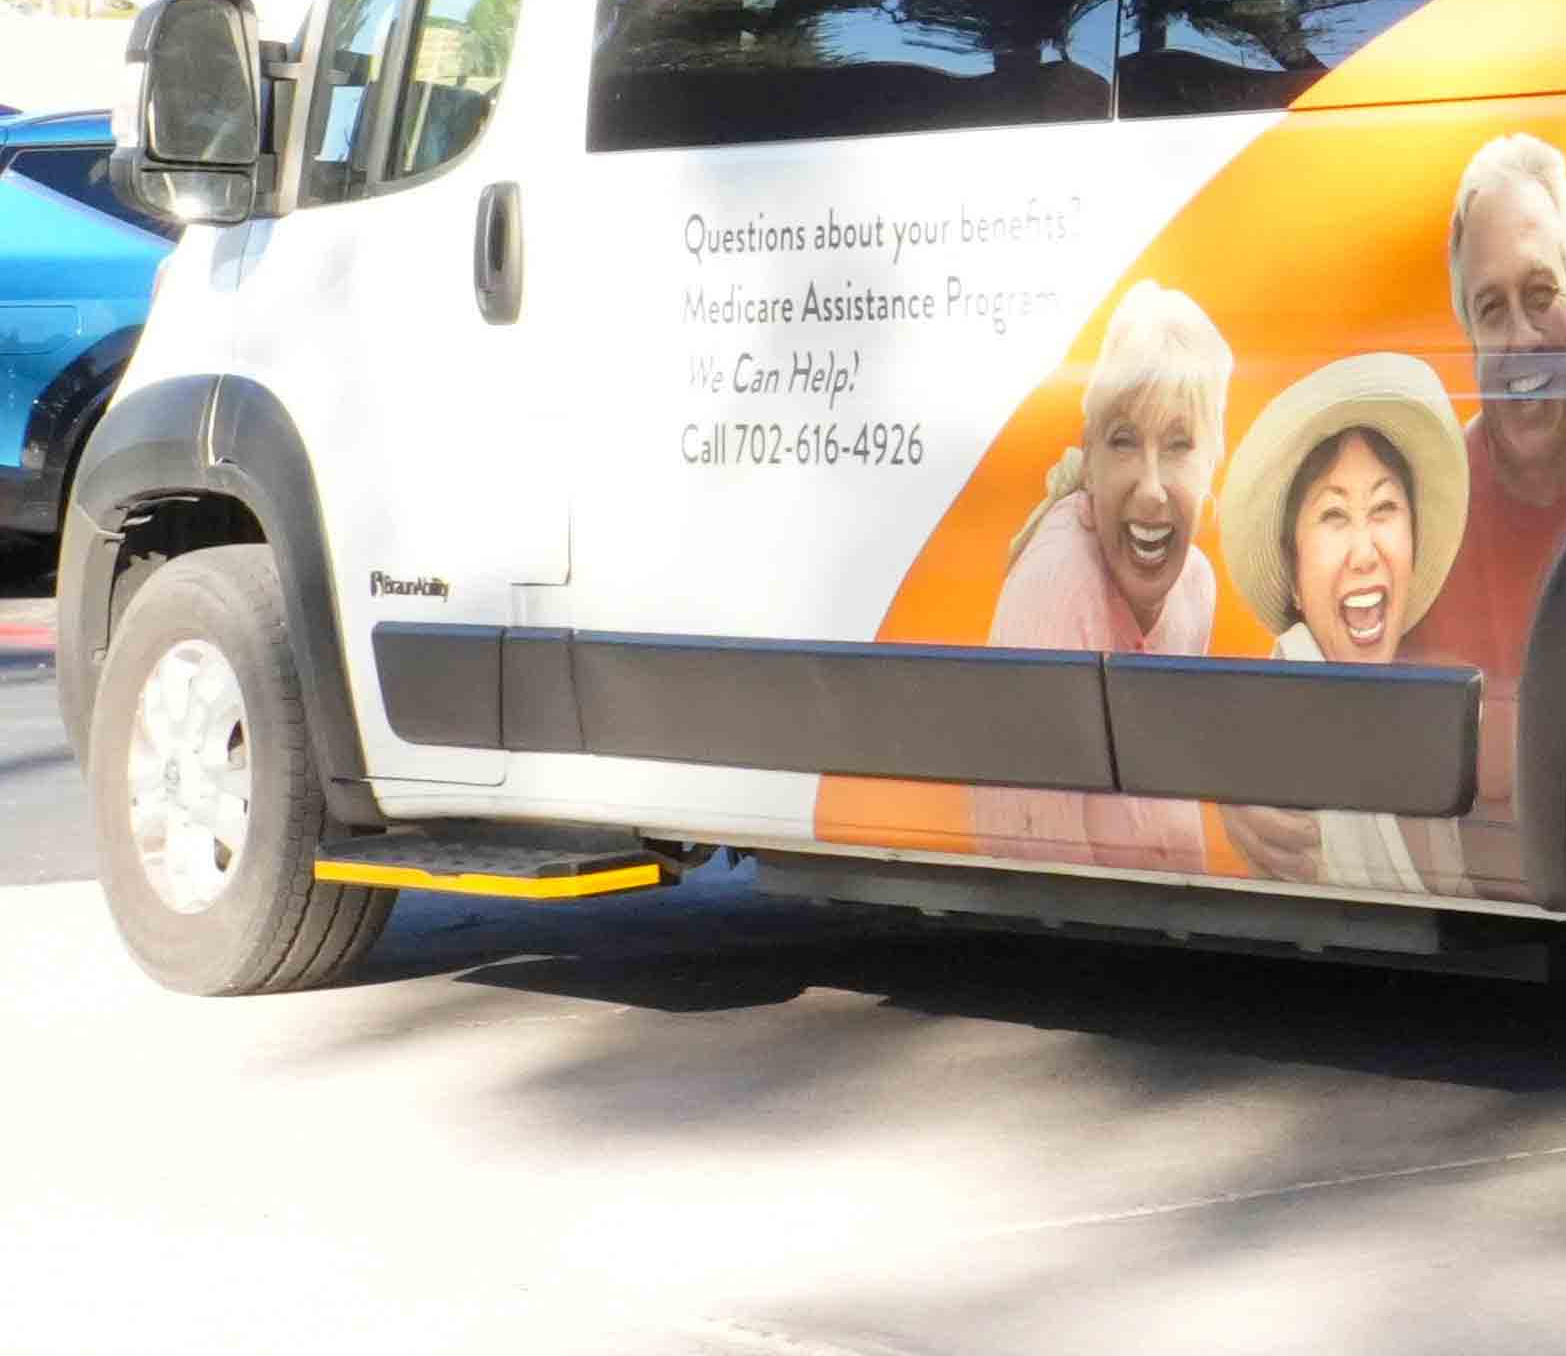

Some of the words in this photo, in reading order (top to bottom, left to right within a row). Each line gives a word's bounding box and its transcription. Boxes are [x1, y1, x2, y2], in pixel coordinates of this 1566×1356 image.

[684, 212, 806, 263] Questions
[814, 207, 885, 250] about
[893, 216, 952, 265] your
[960, 196, 1083, 244] benefits?
[682, 283, 794, 326] Medicare
[801, 281, 936, 324] Assistance
[689, 354, 724, 394] We
[733, 353, 780, 396] Can
[788, 349, 861, 410] Help!
[681, 422, 728, 466] Call
[735, 422, 925, 468] 702-616-4926
